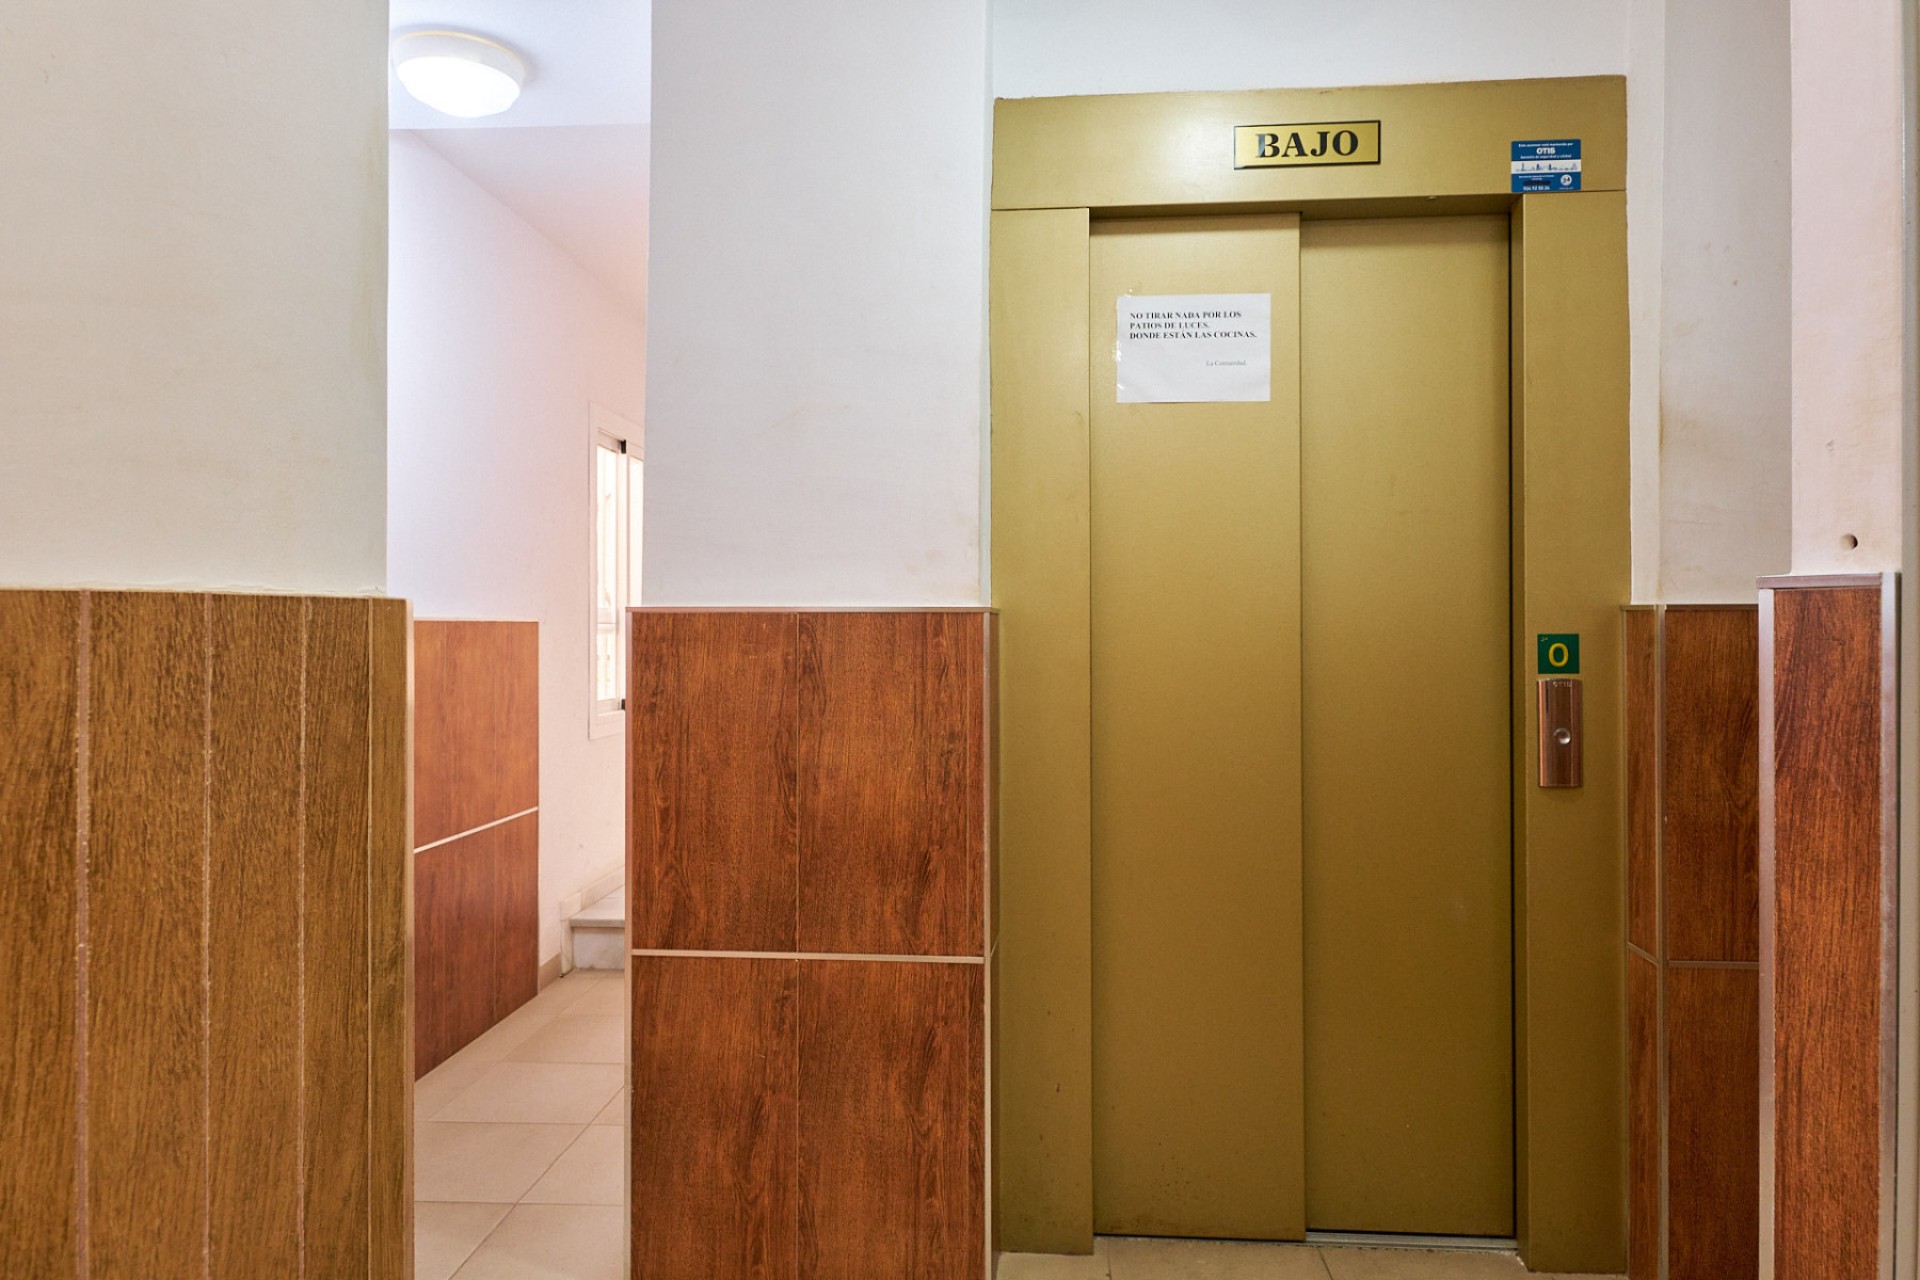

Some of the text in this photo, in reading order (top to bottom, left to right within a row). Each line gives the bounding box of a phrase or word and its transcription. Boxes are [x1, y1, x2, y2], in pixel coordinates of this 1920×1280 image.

[1256, 130, 1358, 158] BAJO
[1175, 311, 1200, 319] NADA
[1203, 311, 1221, 319] POR
[1130, 322, 1162, 330] PATIOS
[1129, 331, 1160, 339] DONDE
[1163, 329, 1193, 339] ESTÁN
[1195, 331, 1212, 339] LAS
